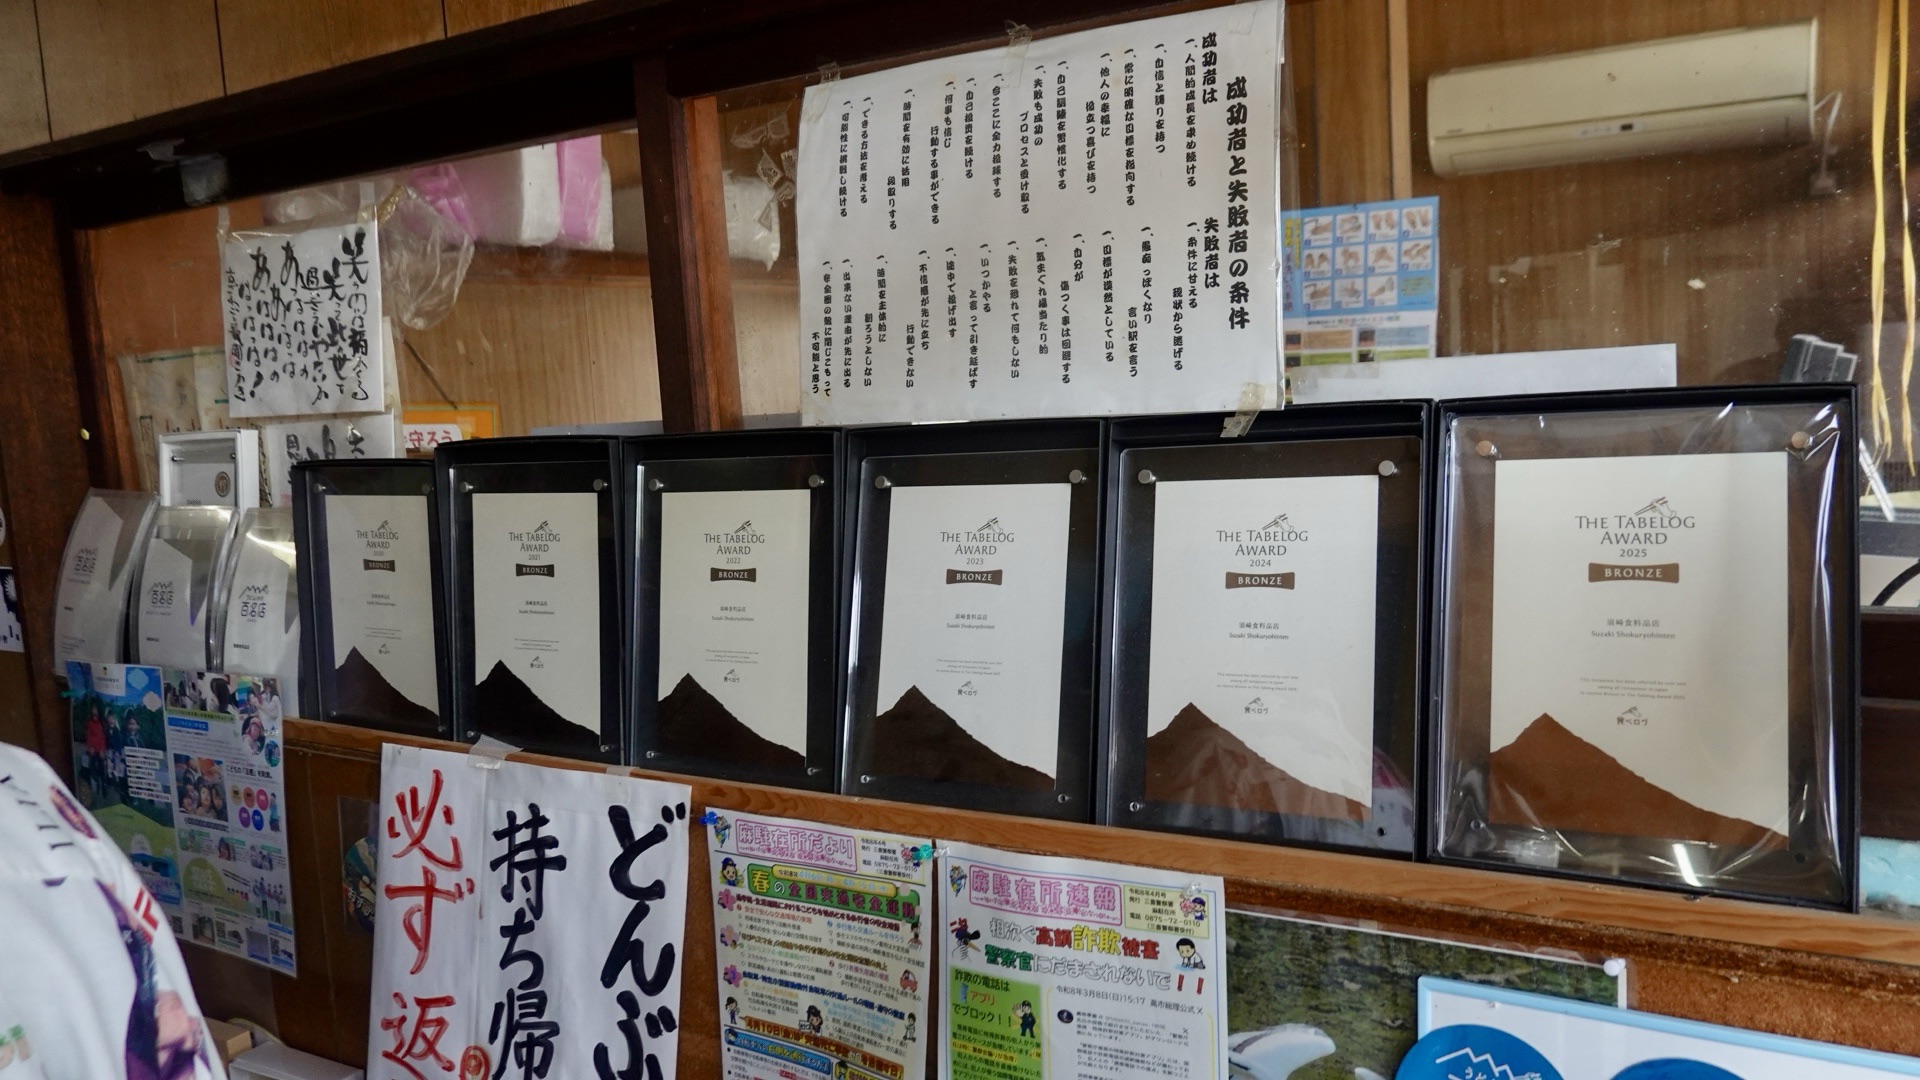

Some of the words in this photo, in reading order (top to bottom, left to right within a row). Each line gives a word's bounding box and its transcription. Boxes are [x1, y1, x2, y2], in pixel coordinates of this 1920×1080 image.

[1202, 32, 1217, 104] 成功者は
[1227, 76, 1250, 329] 成功者と失敗者の条件
[1204, 217, 1219, 288] 失敗者は
[1574, 515, 1609, 529] THE
[1614, 515, 1696, 529] TABELOG
[509, 532, 523, 542] THE
[525, 532, 561, 542] TABELOG
[703, 533, 721, 544] THE
[724, 533, 765, 544] TABELOG
[940, 531, 961, 543] THE
[964, 531, 1015, 543] TABELOG
[1216, 530, 1242, 542] THE
[1246, 530, 1308, 542] TABELOG
[1600, 531, 1668, 545] AWARD
[520, 543, 549, 553] AWARD
[716, 545, 751, 555] AWARD
[955, 544, 997, 555] AWARD
[1235, 544, 1287, 556] AWARD
[1619, 549, 1647, 558] 2025
[1249, 559, 1272, 567] 2024
[718, 571, 748, 579] BRONZE
[956, 573, 993, 581] BRONZE
[1604, 568, 1663, 578] BRONZE
[1238, 576, 1282, 585] BRONZE
[1591, 630, 1615, 638] Suzaki
[1616, 631, 1676, 640] Shokuryohinten
[972, 870, 1116, 911] 麻駐在所速報
[381, 769, 475, 1080] 必ず返
[1144, 914, 1201, 927] 0875-72-0110
[489, 803, 567, 1080] 持ち帰
[989, 917, 1160, 960] 相次ぐ高額詐欺被害
[954, 969, 1011, 992] 詐欺の電話は
[970, 990, 996, 1006] アプリ
